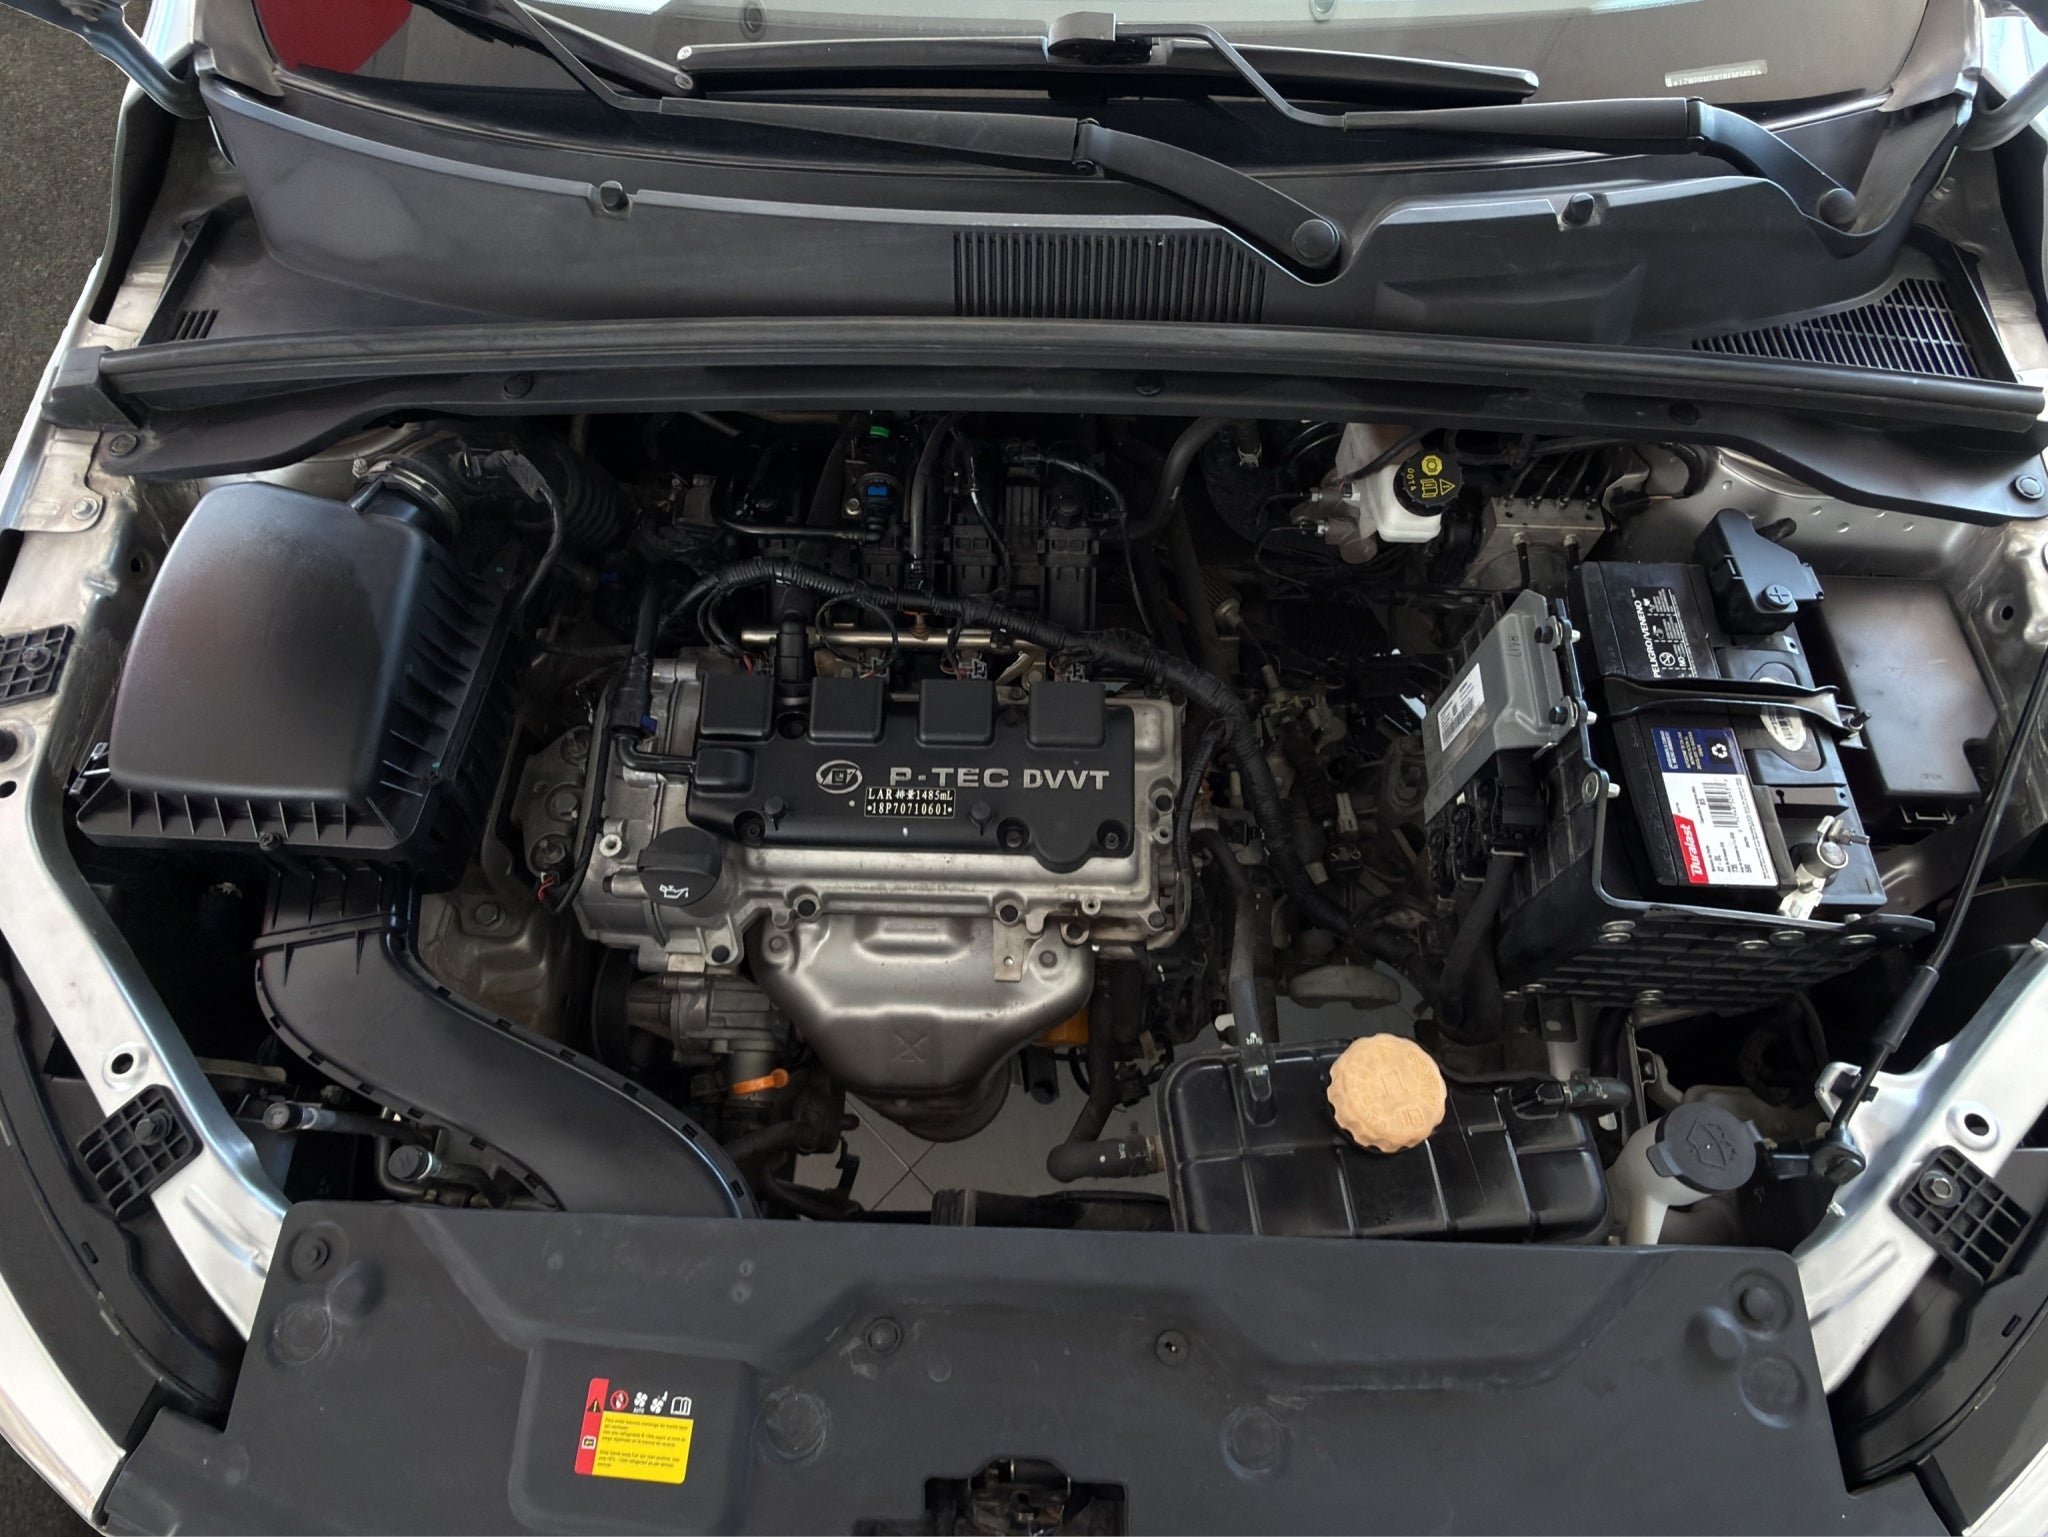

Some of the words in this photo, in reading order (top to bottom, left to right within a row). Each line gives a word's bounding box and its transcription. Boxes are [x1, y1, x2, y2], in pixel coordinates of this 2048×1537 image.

[1634, 600, 1661, 678] PELIGRO/VENENO
[890, 767, 1009, 788] P-TEC
[1023, 769, 1110, 790] DVVT
[1680, 824, 1703, 876] Duralast
